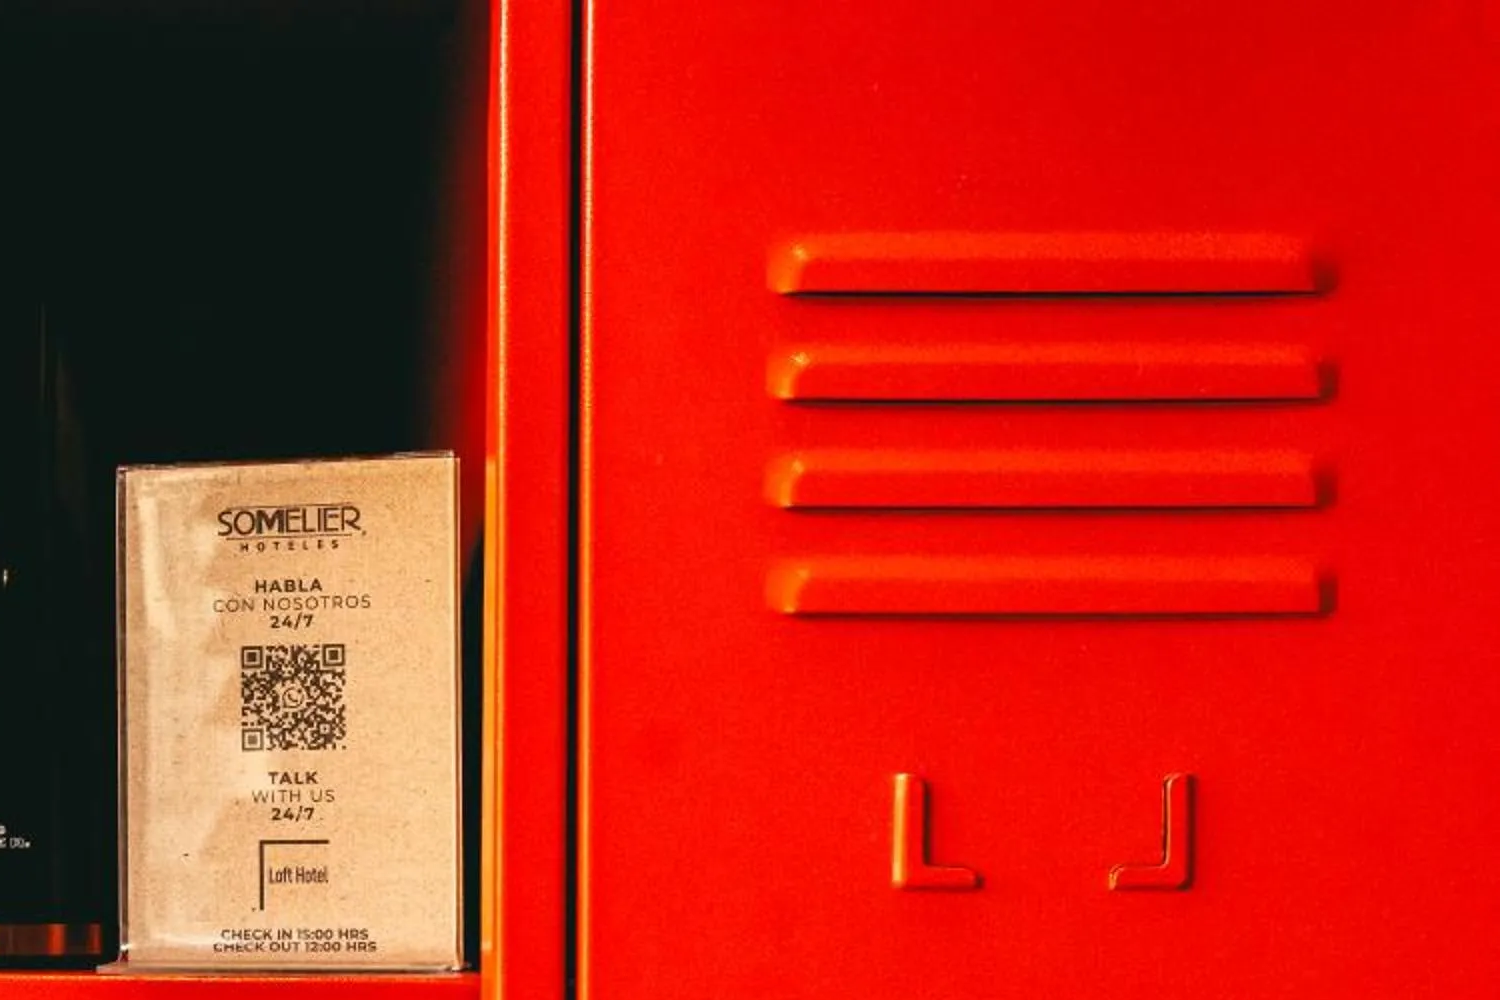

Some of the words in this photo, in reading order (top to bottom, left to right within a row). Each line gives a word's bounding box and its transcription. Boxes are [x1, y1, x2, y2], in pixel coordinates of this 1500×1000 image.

[240, 539, 339, 552] HOTELES
[255, 578, 323, 594] HABLA
[213, 599, 255, 612] CON
[263, 595, 372, 611] NOSOTROS
[269, 613, 314, 630] 24/7
[268, 771, 319, 785] TALK
[252, 789, 301, 803] WITH
[311, 789, 336, 803] US
[271, 806, 315, 822] 24/7
[269, 867, 293, 884] Loft
[221, 929, 273, 941] CHECK
[277, 929, 293, 940] IN
[297, 929, 334, 940] 15:00
[338, 928, 369, 940] HRS
[213, 942, 264, 953] CHECK
[269, 941, 300, 953] OUT
[304, 941, 341, 952] 12:00
[345, 941, 377, 953] HRS
